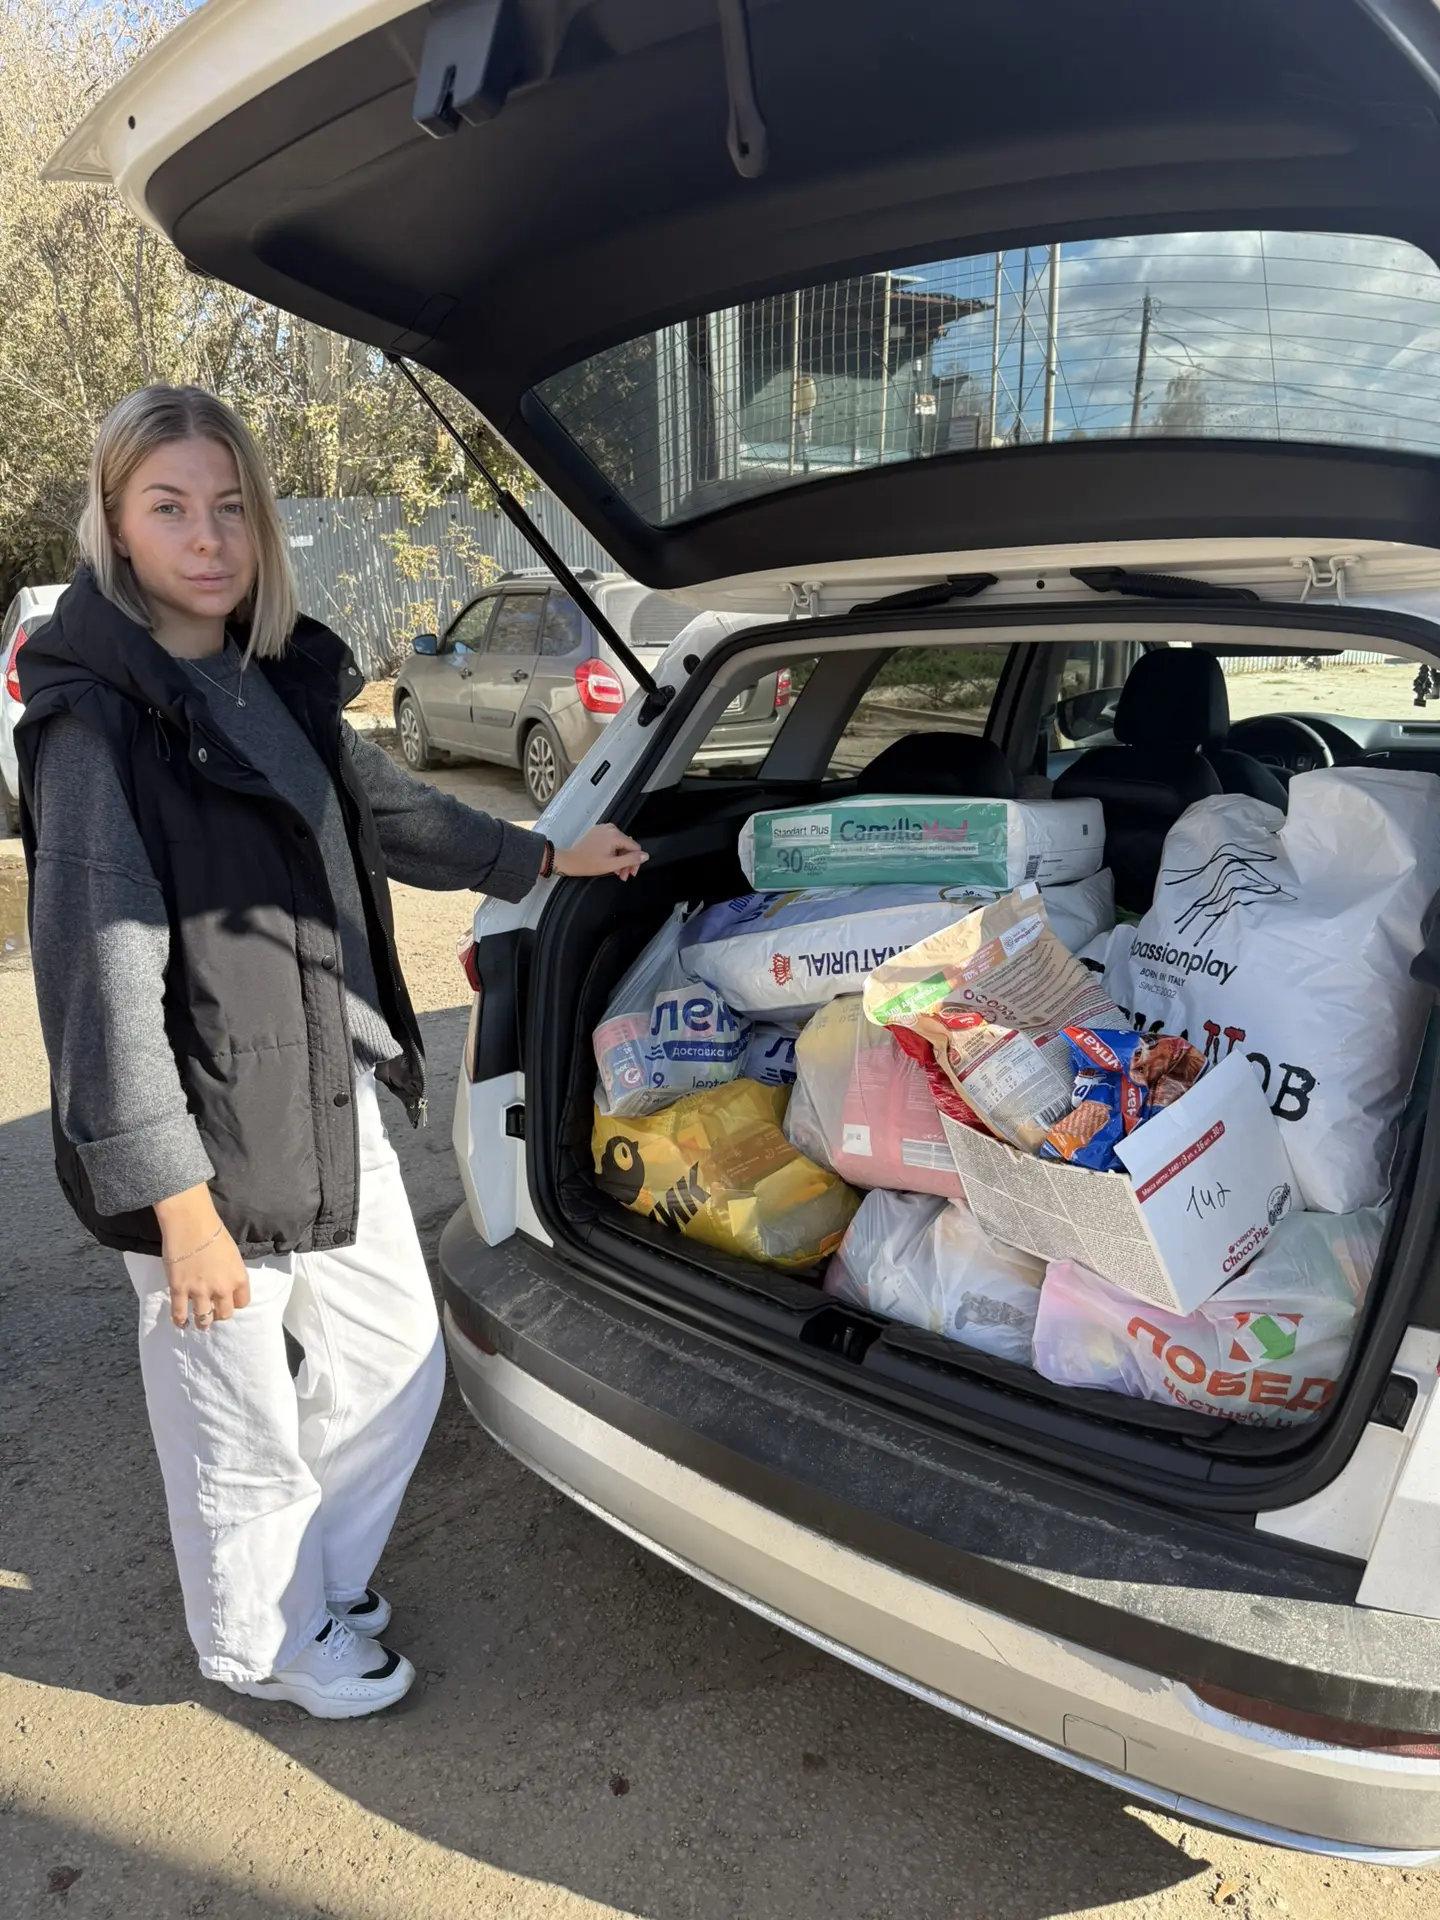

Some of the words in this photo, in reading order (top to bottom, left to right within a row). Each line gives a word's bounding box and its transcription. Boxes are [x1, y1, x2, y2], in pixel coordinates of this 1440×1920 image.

[774, 827, 807, 839] Standart
[811, 825, 829, 836] Plus
[777, 848, 803, 873] 30
[799, 946, 911, 977] NATURIAL
[1167, 974, 1186, 987] ITALY
[672, 1045, 726, 1058] доставка
[1234, 1225, 1257, 1248] ORION
